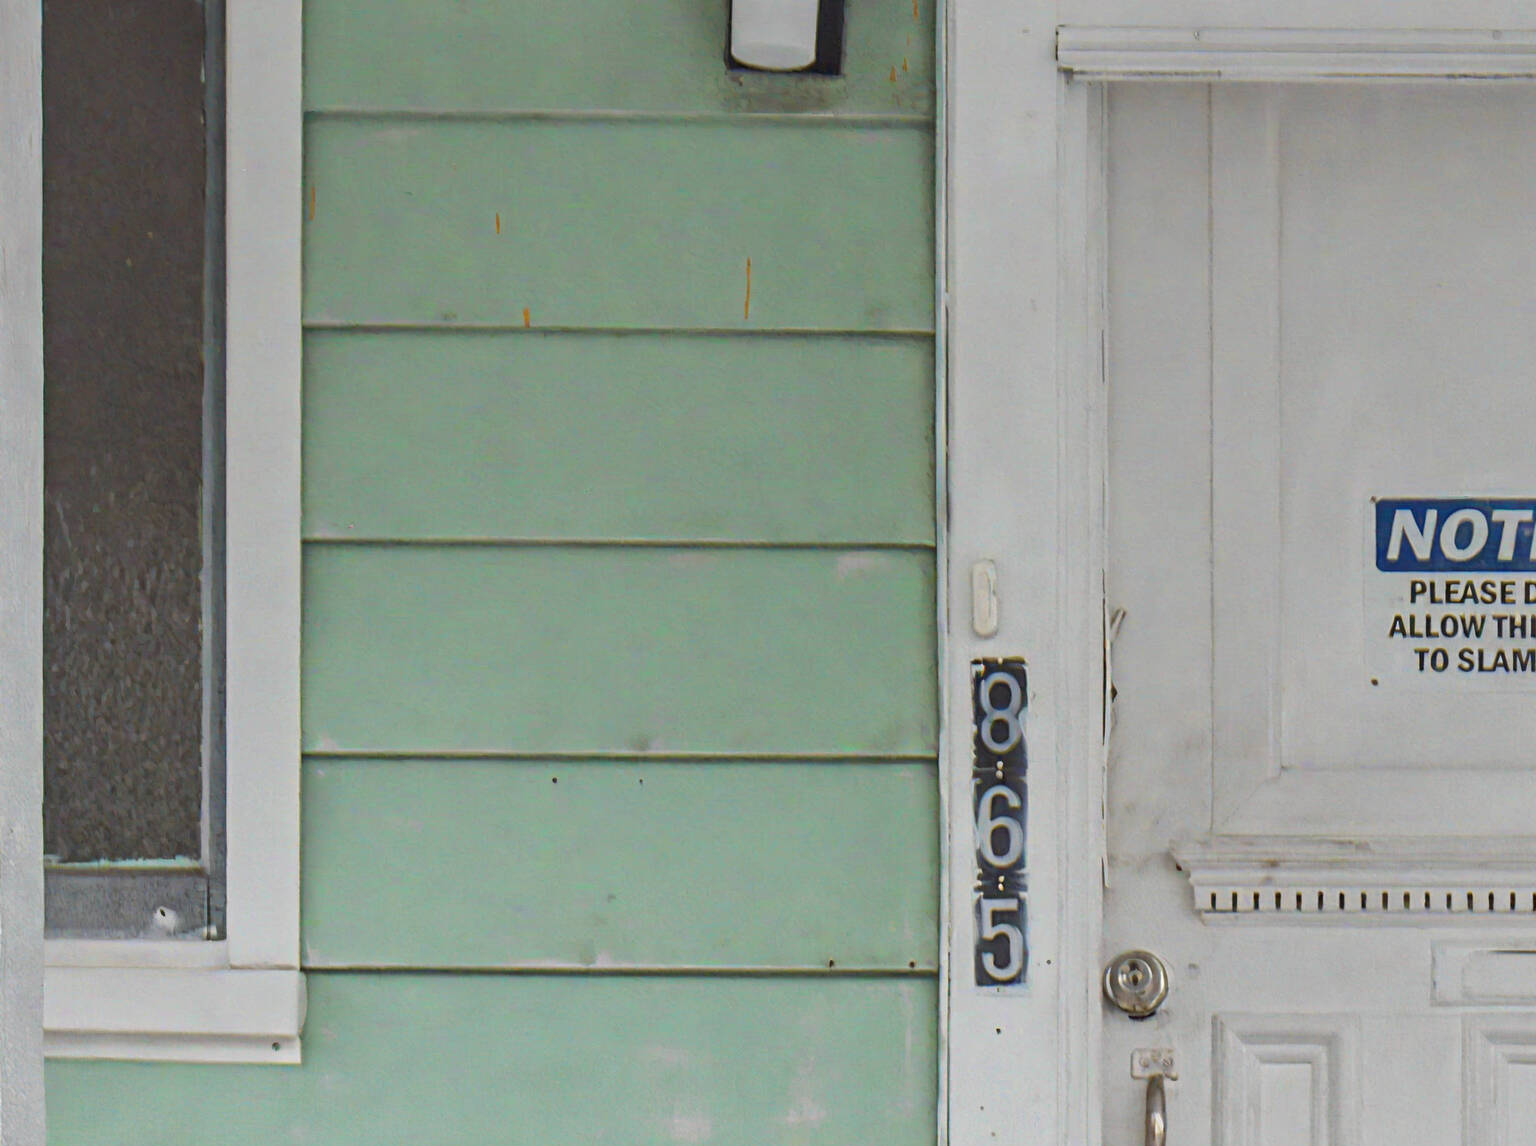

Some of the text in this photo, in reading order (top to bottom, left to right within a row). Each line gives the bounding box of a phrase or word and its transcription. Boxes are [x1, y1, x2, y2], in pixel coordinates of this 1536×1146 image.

[1409, 579, 1517, 605] PLEASE
[1388, 614, 1487, 639] ALLOW
[1413, 647, 1449, 673] TO
[1457, 647, 1536, 673] SLAM
[977, 671, 1024, 982] 865
